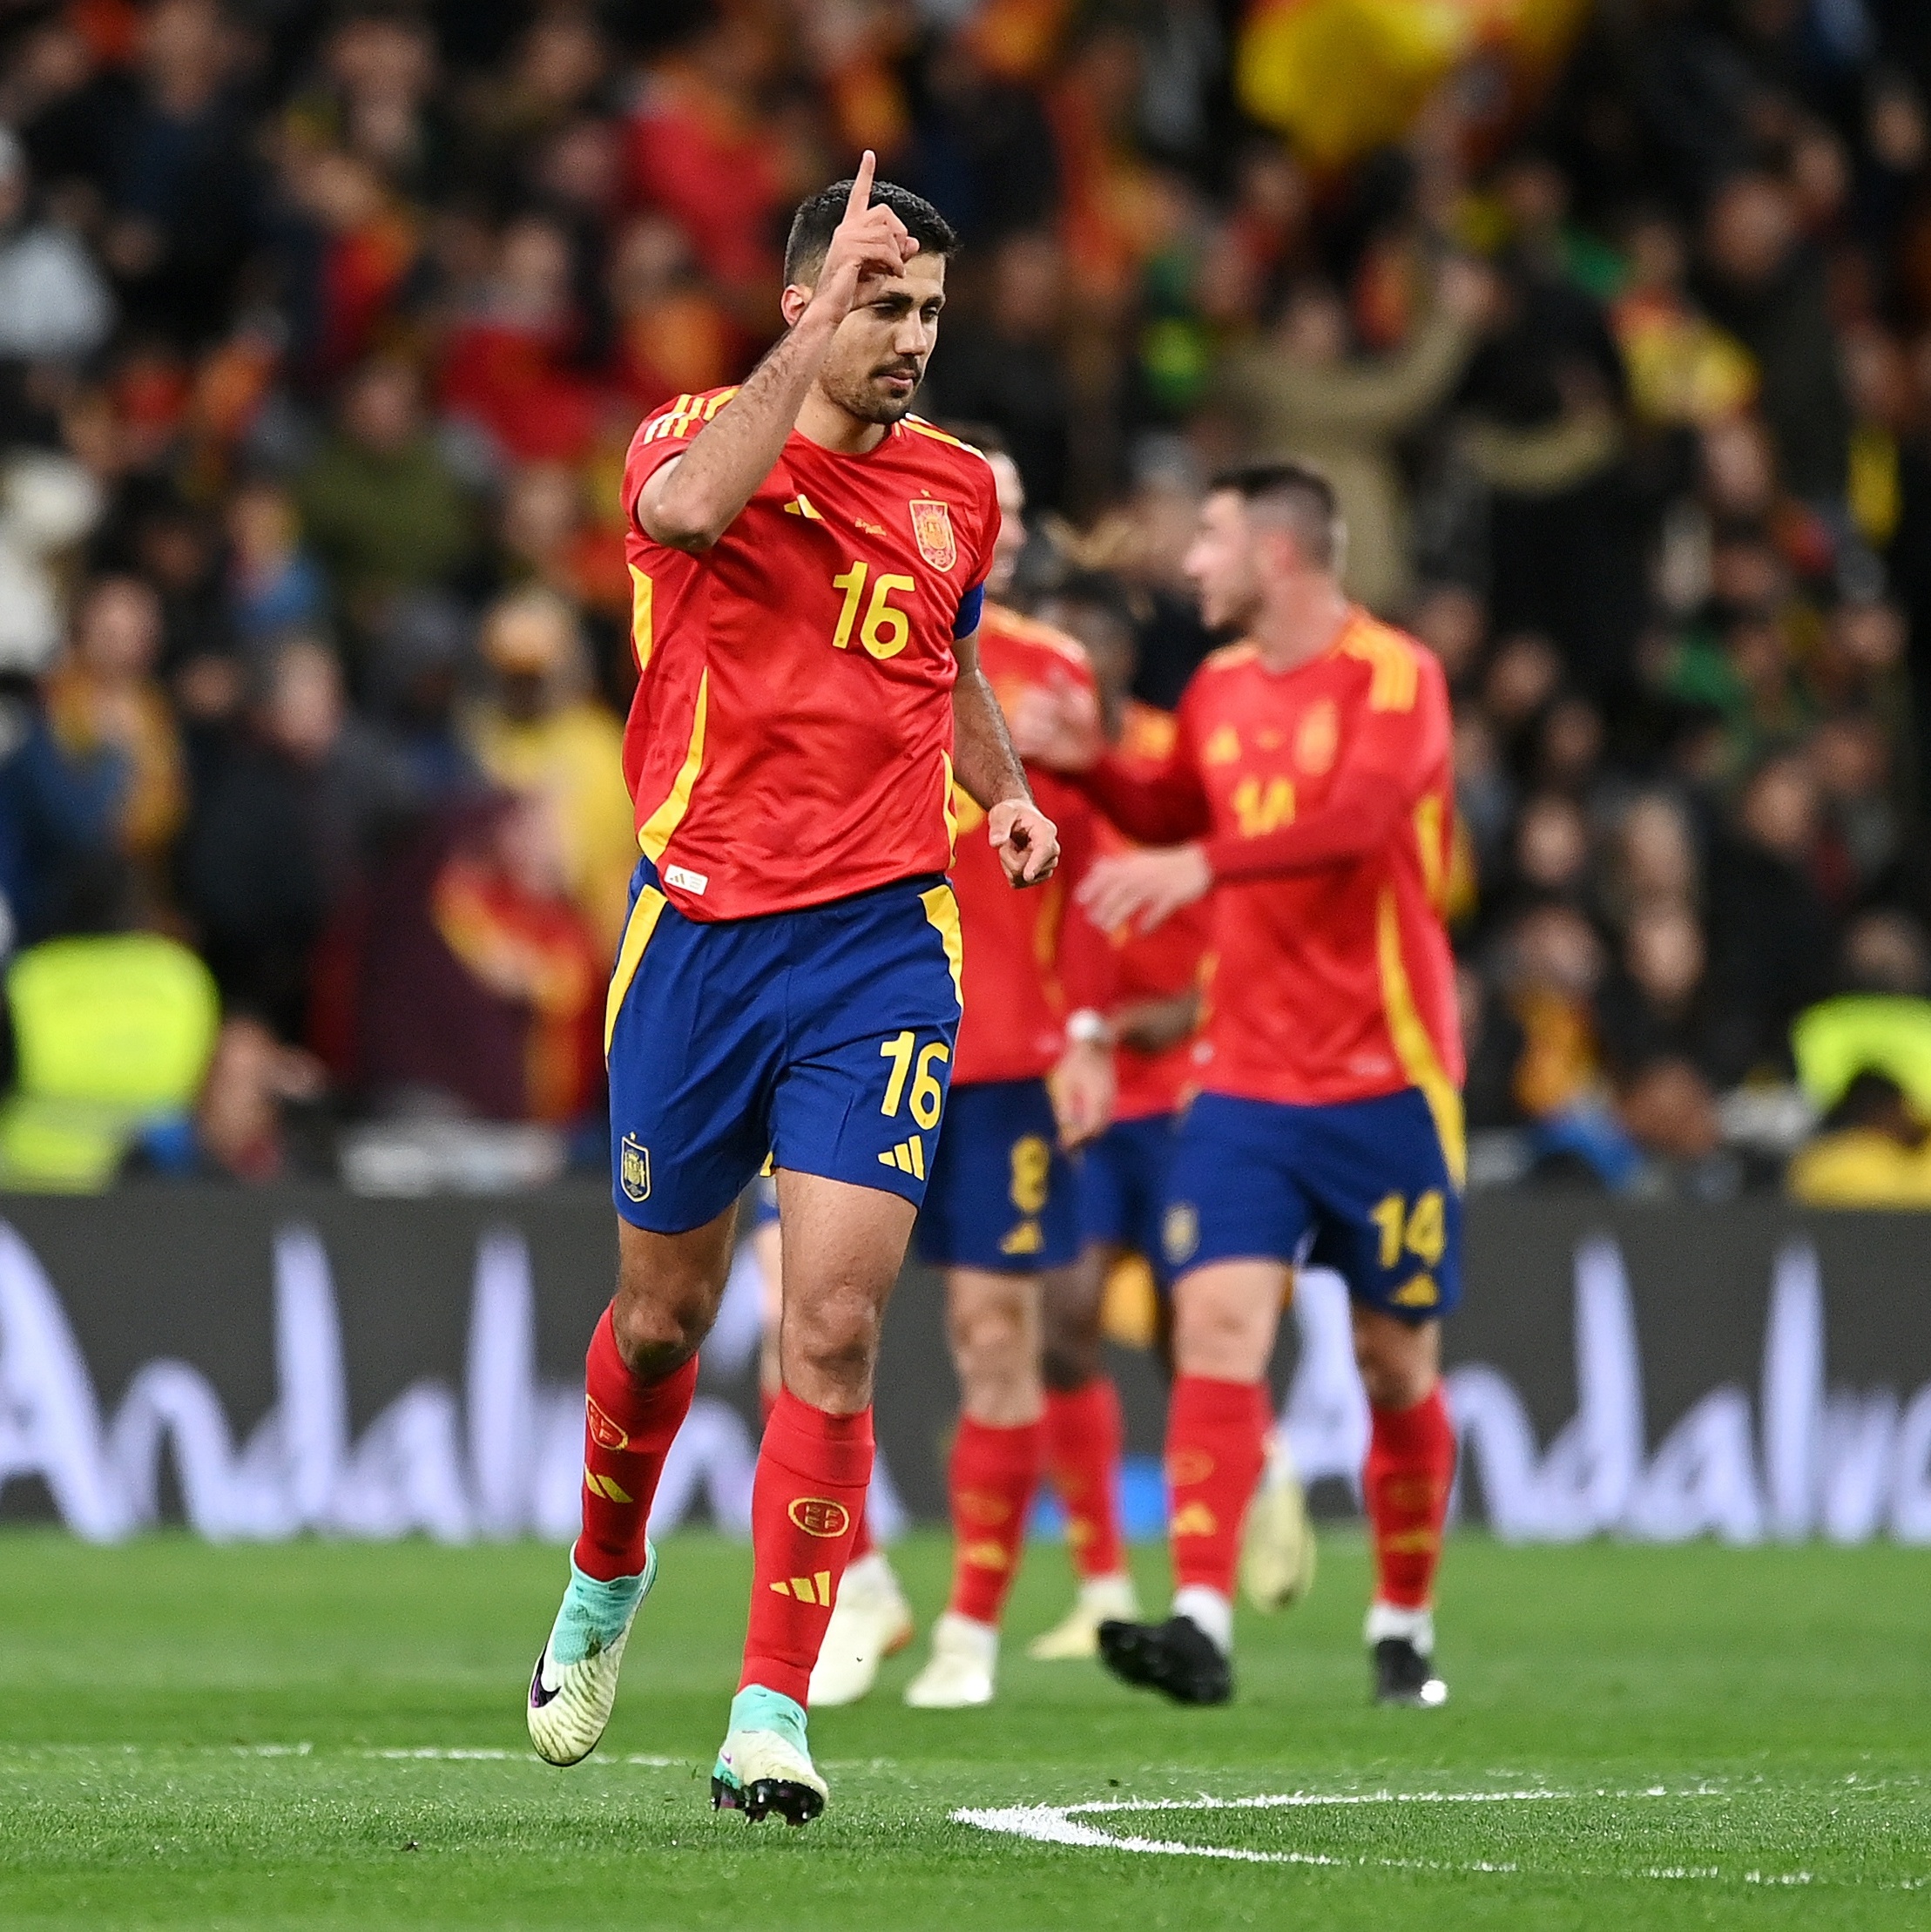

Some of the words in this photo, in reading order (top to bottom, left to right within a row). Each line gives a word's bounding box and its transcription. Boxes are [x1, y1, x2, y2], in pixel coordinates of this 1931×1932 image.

[833, 560, 915, 659] 16
[1231, 774, 1296, 839] 14
[880, 1030, 949, 1130] 16
[1369, 1190, 1445, 1269] 14
